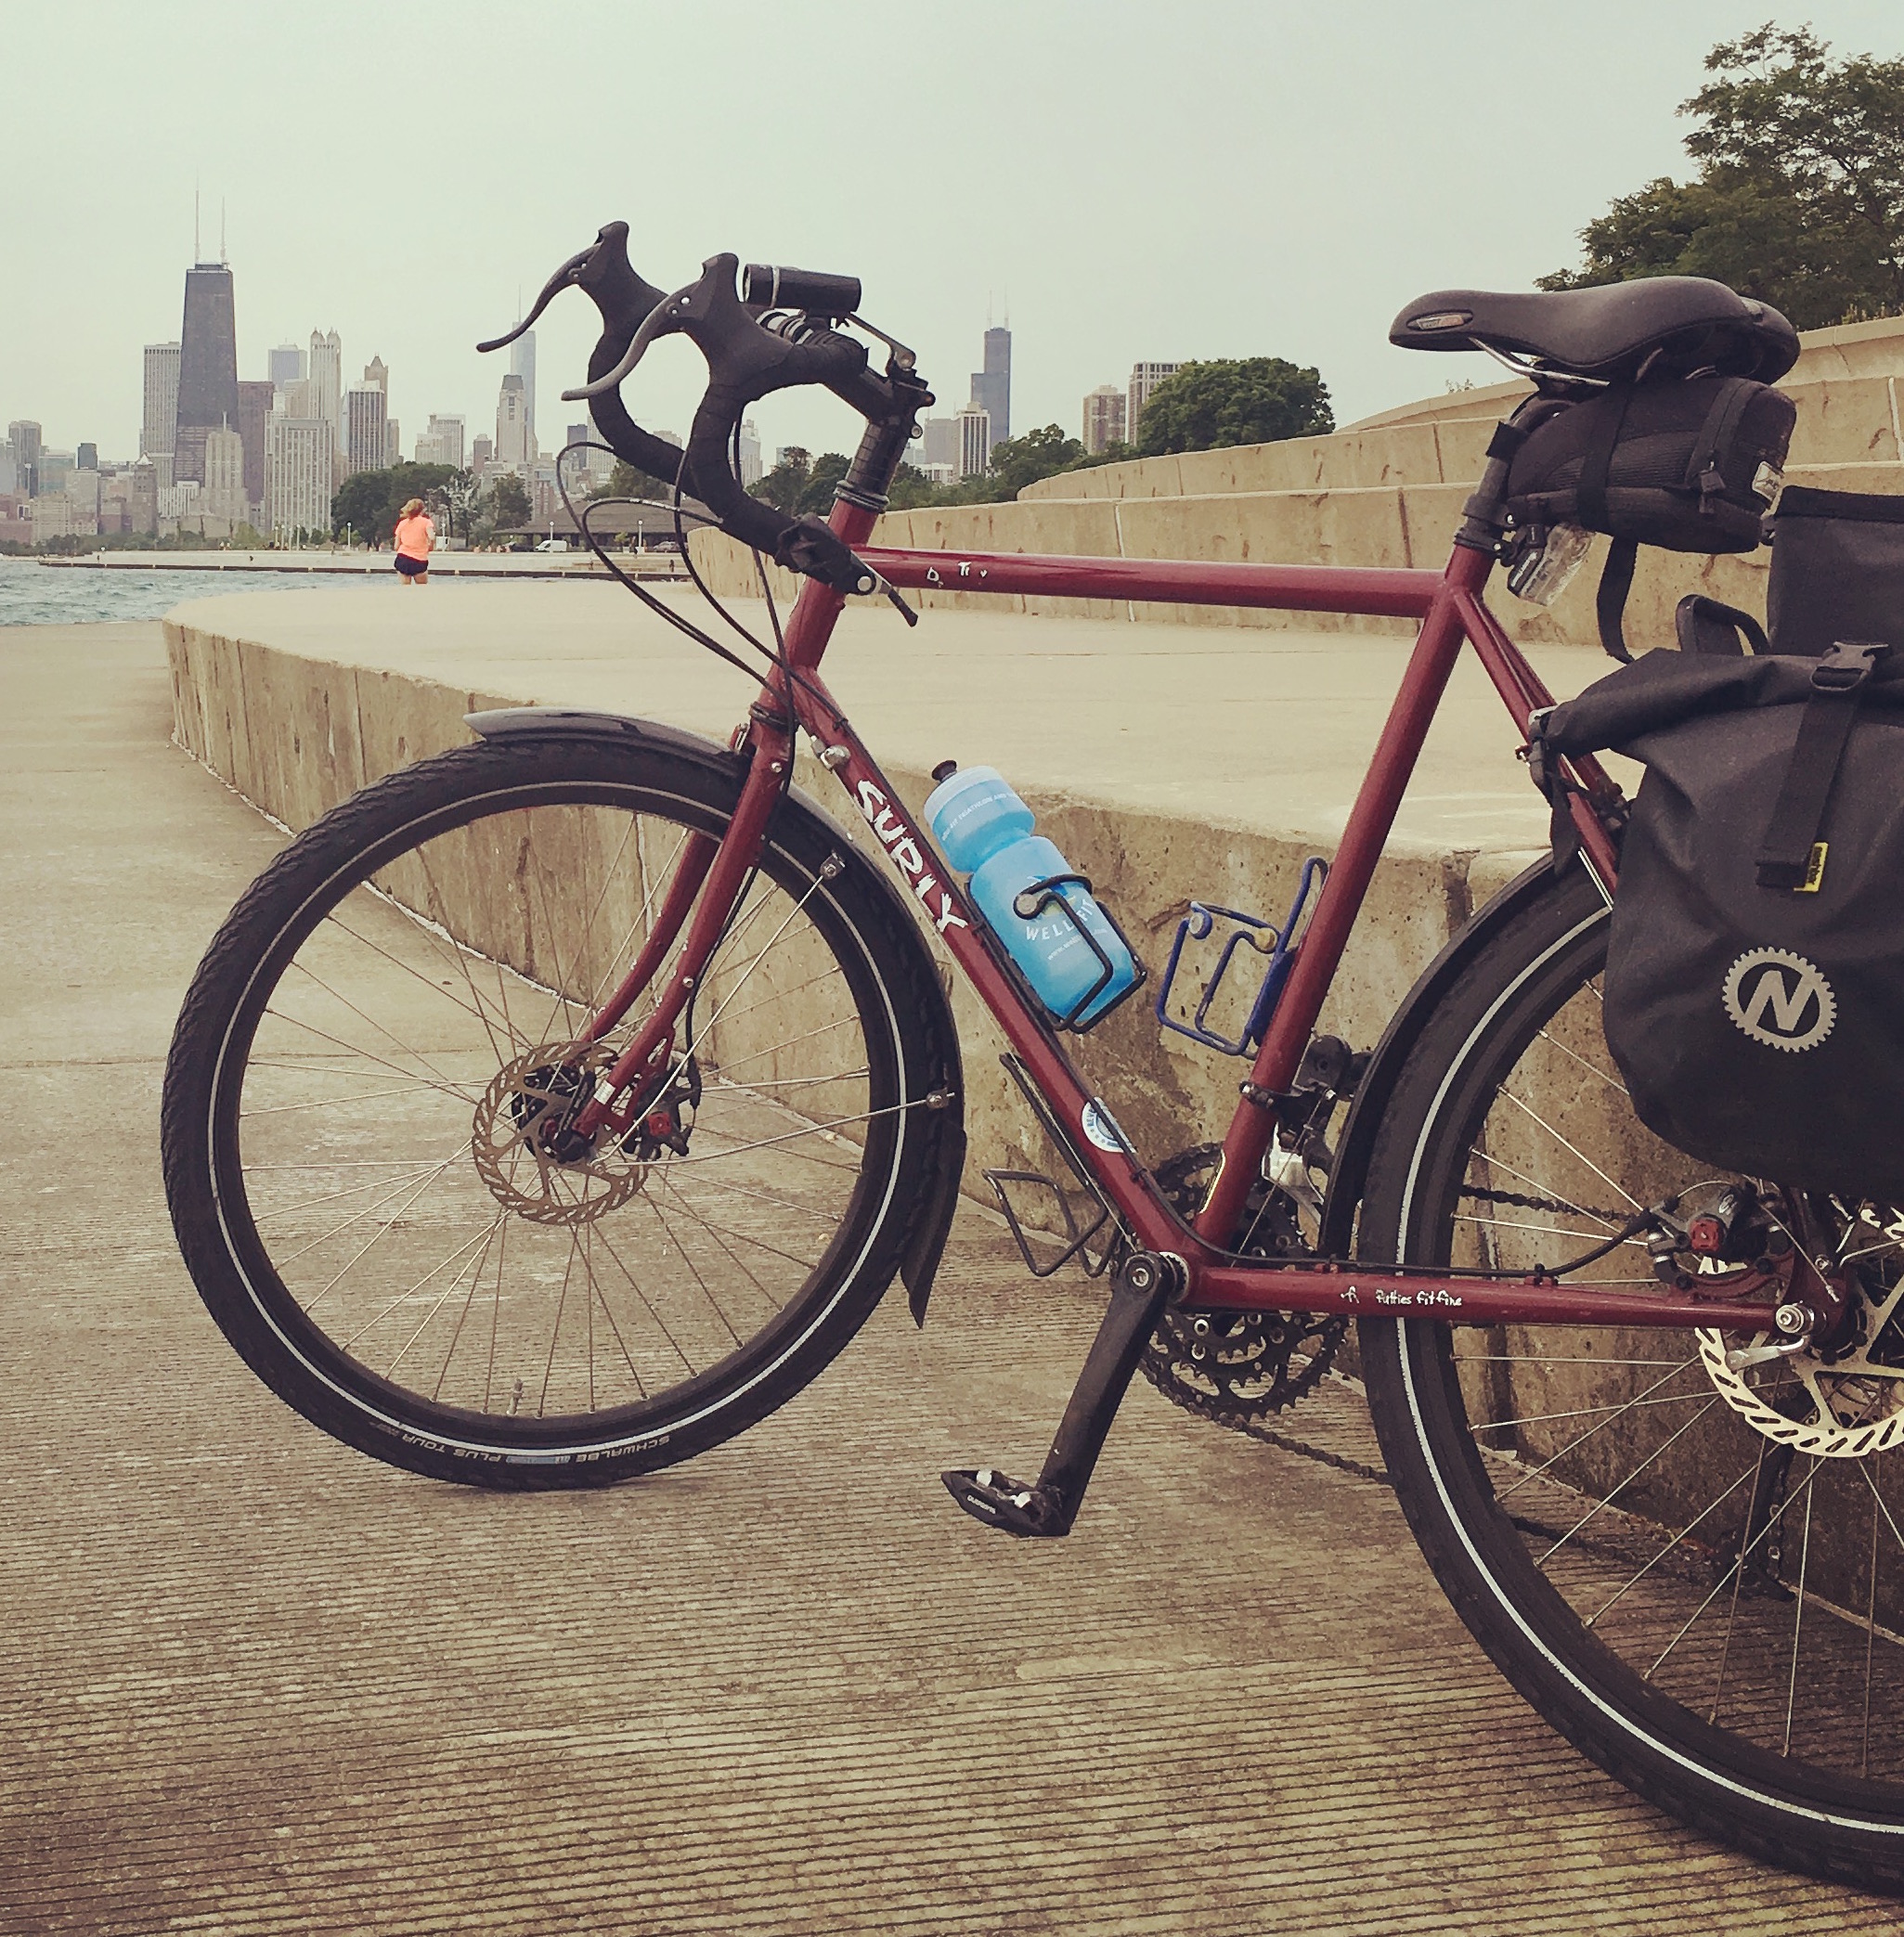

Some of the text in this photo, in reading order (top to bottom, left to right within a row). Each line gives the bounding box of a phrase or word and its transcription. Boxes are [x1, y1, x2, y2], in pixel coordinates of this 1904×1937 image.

[853, 780, 968, 933] SURLY
[1026, 898, 1094, 941] WELL FIT
[401, 1432, 447, 1453] TOUR
[452, 1448, 502, 1464] PLUS
[575, 1435, 671, 1464] SCHWALBE
